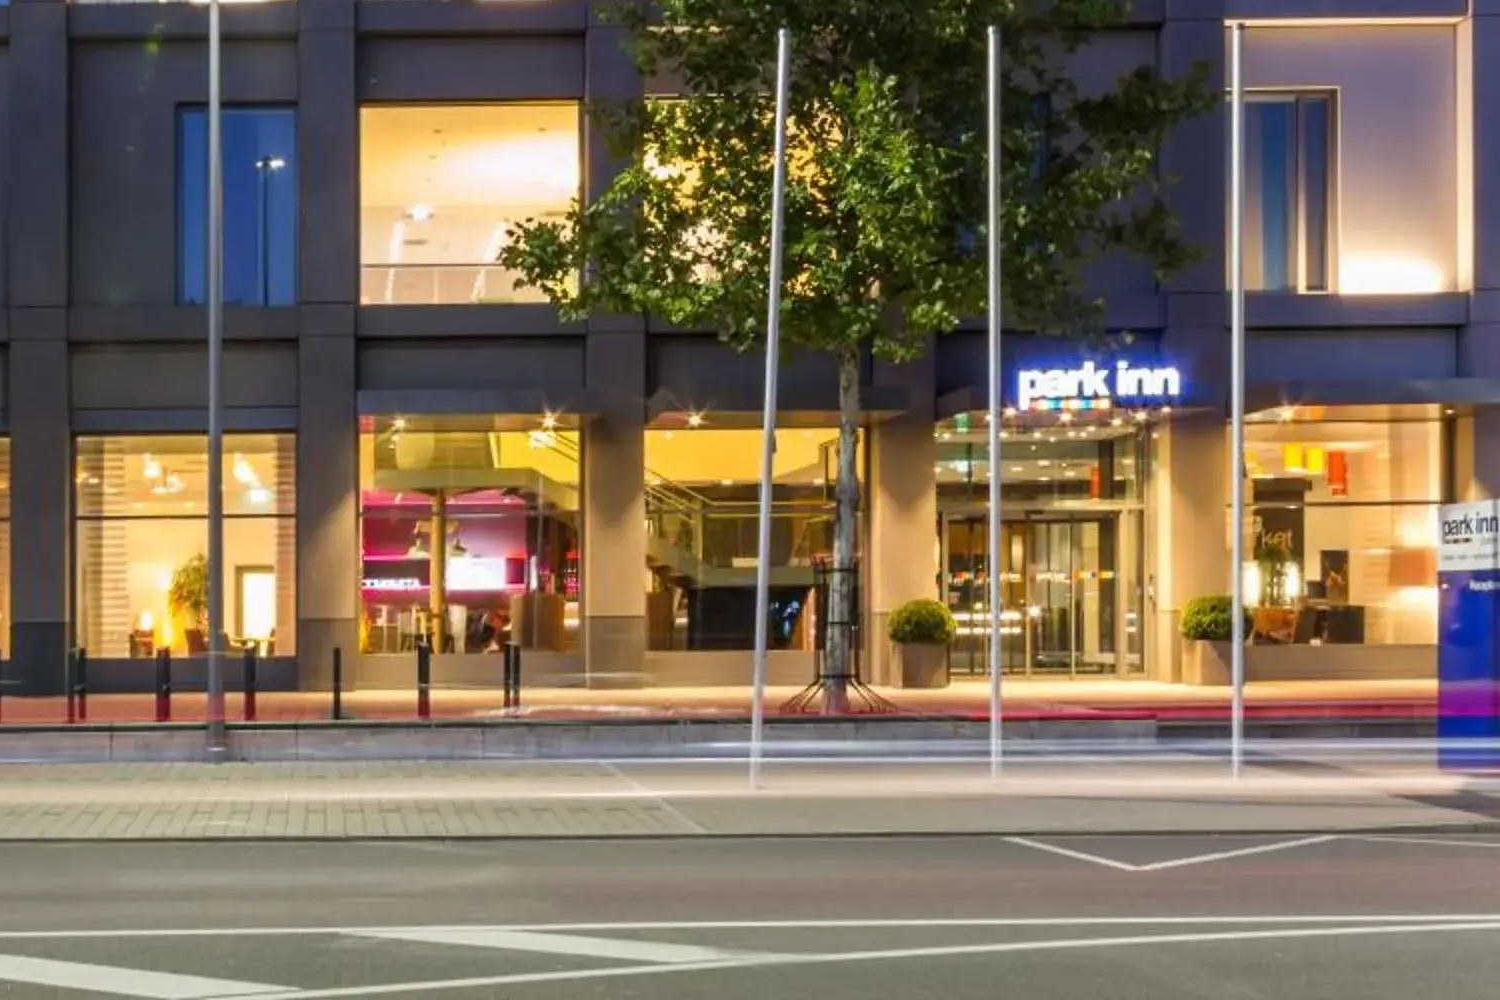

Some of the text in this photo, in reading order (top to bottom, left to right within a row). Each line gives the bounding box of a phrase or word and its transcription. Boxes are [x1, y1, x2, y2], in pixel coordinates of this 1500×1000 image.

[1019, 360, 1180, 410] park inn
[1443, 511, 1498, 542] park inn
